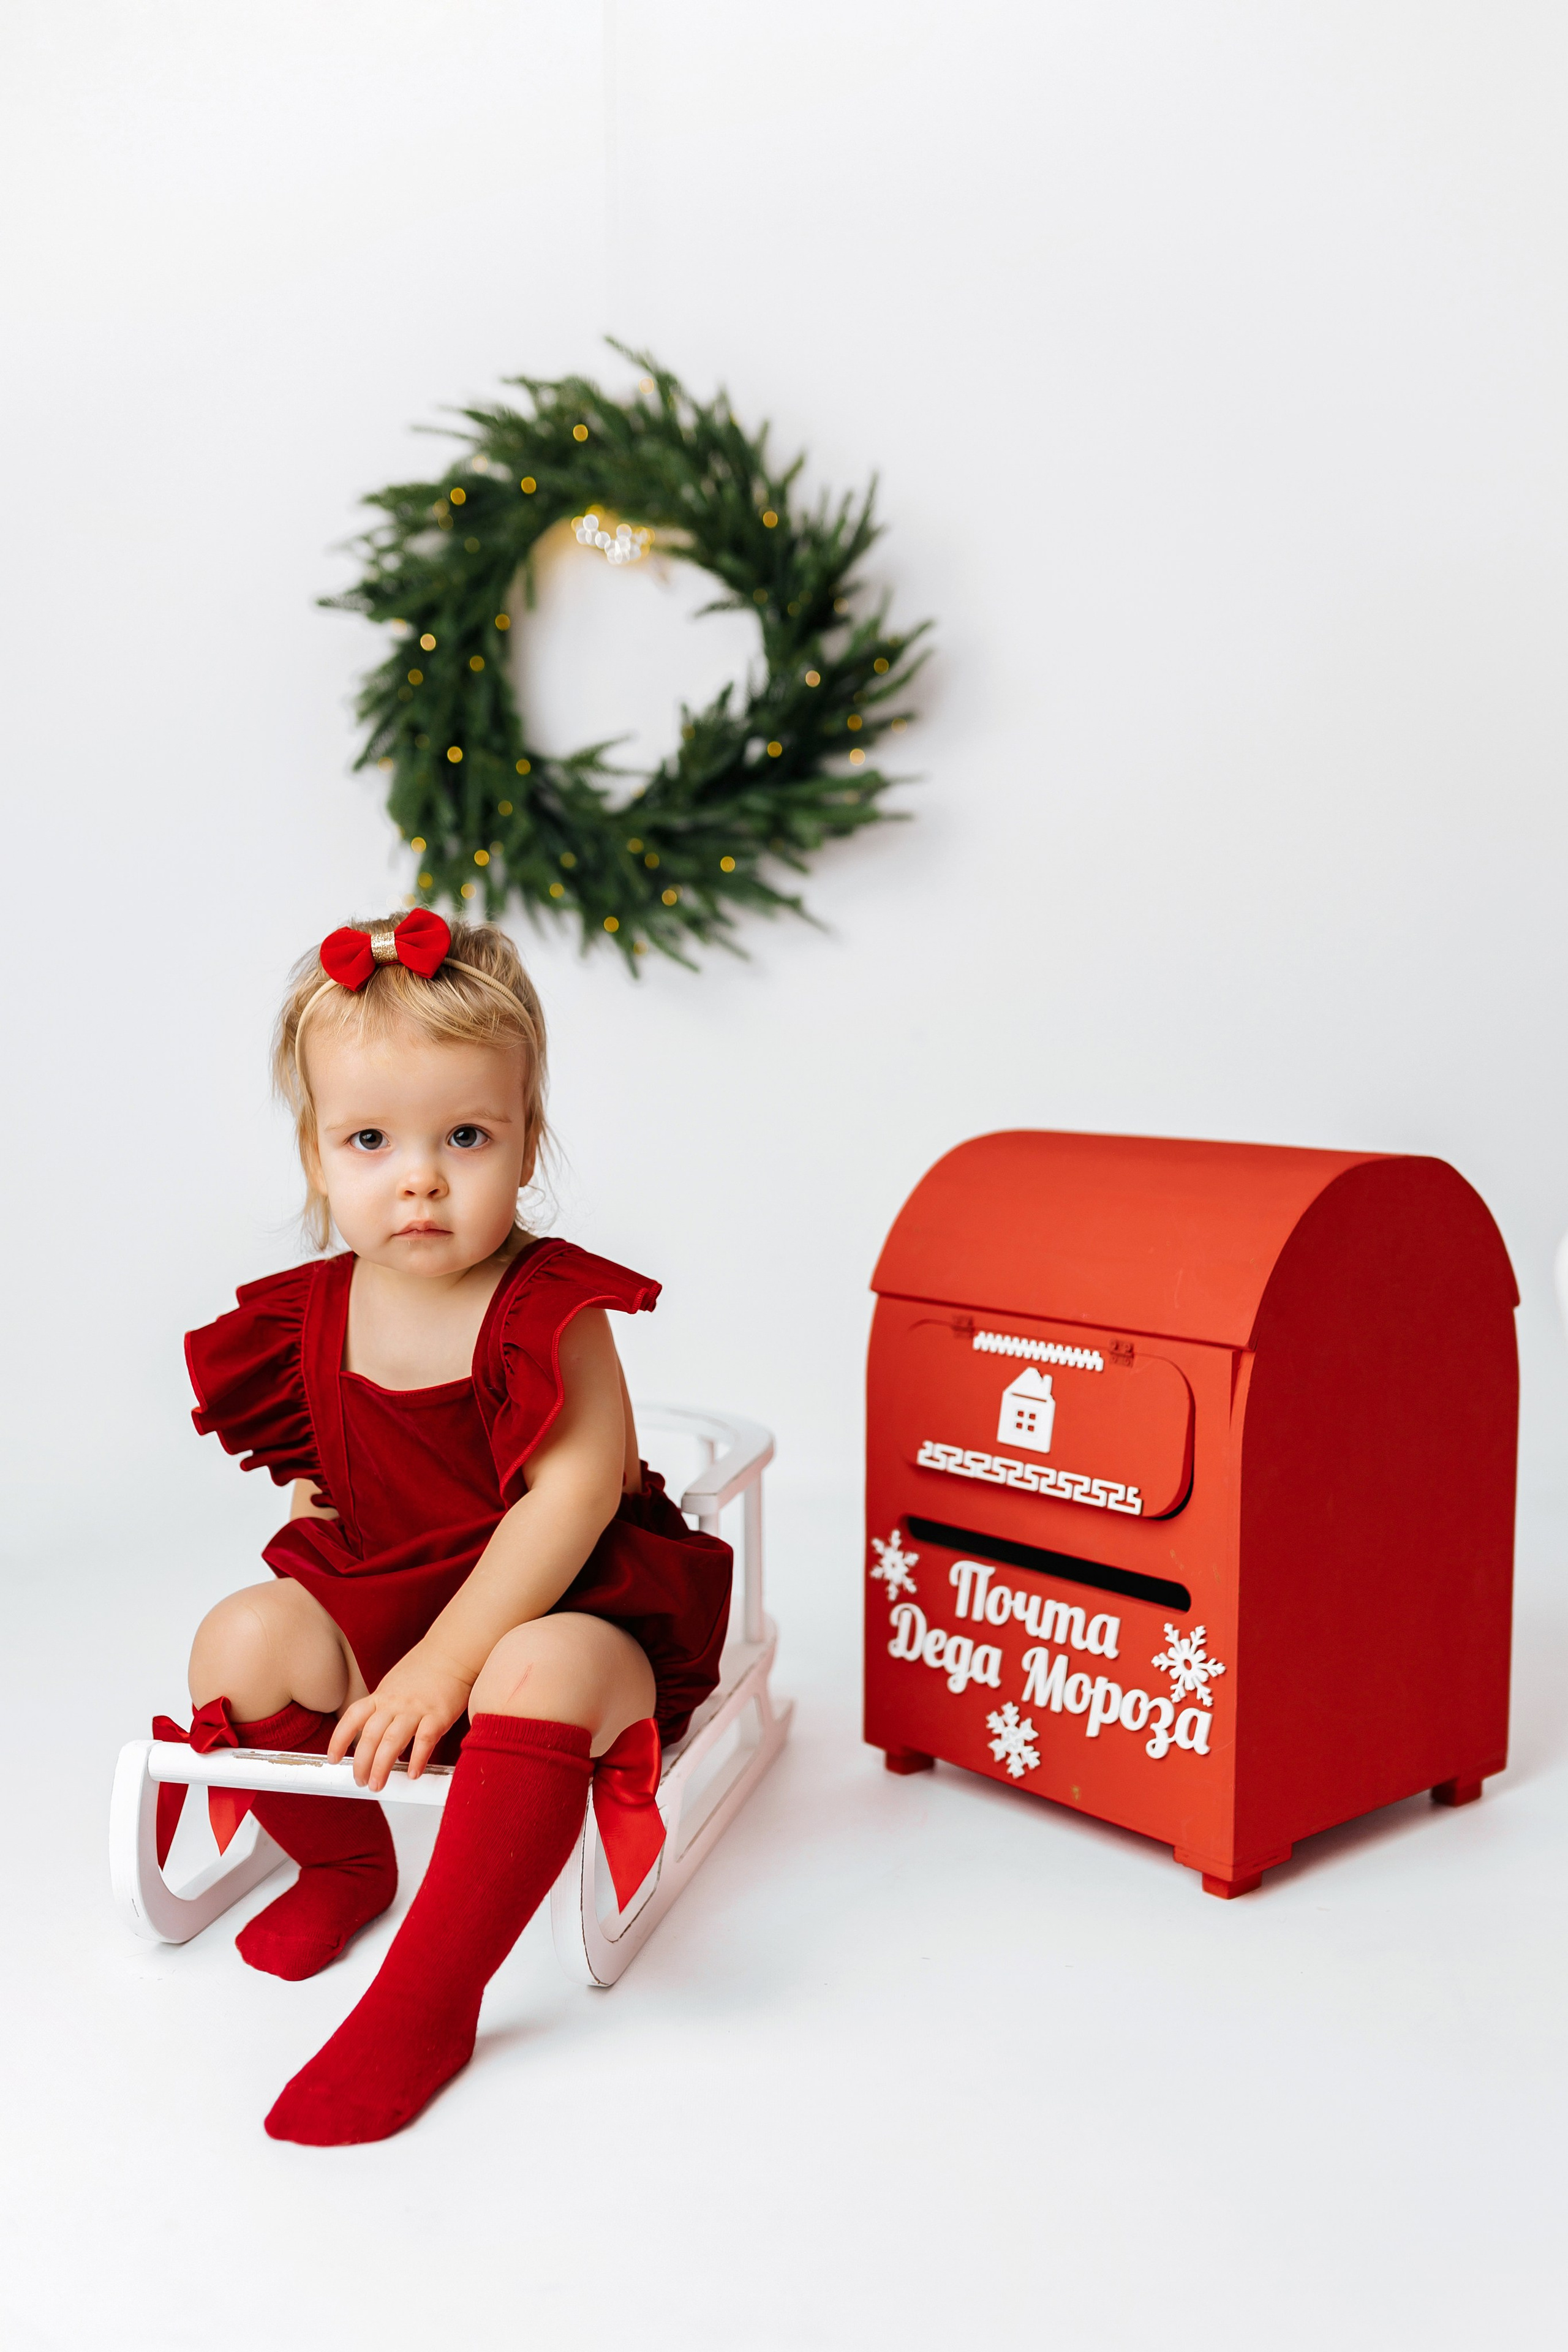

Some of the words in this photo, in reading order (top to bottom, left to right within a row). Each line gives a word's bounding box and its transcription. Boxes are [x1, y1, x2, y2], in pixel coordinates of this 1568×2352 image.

[949, 1560, 1120, 1659] Почта
[888, 1603, 1002, 1694] Деда
[1021, 1646, 1213, 1759] Мороза
